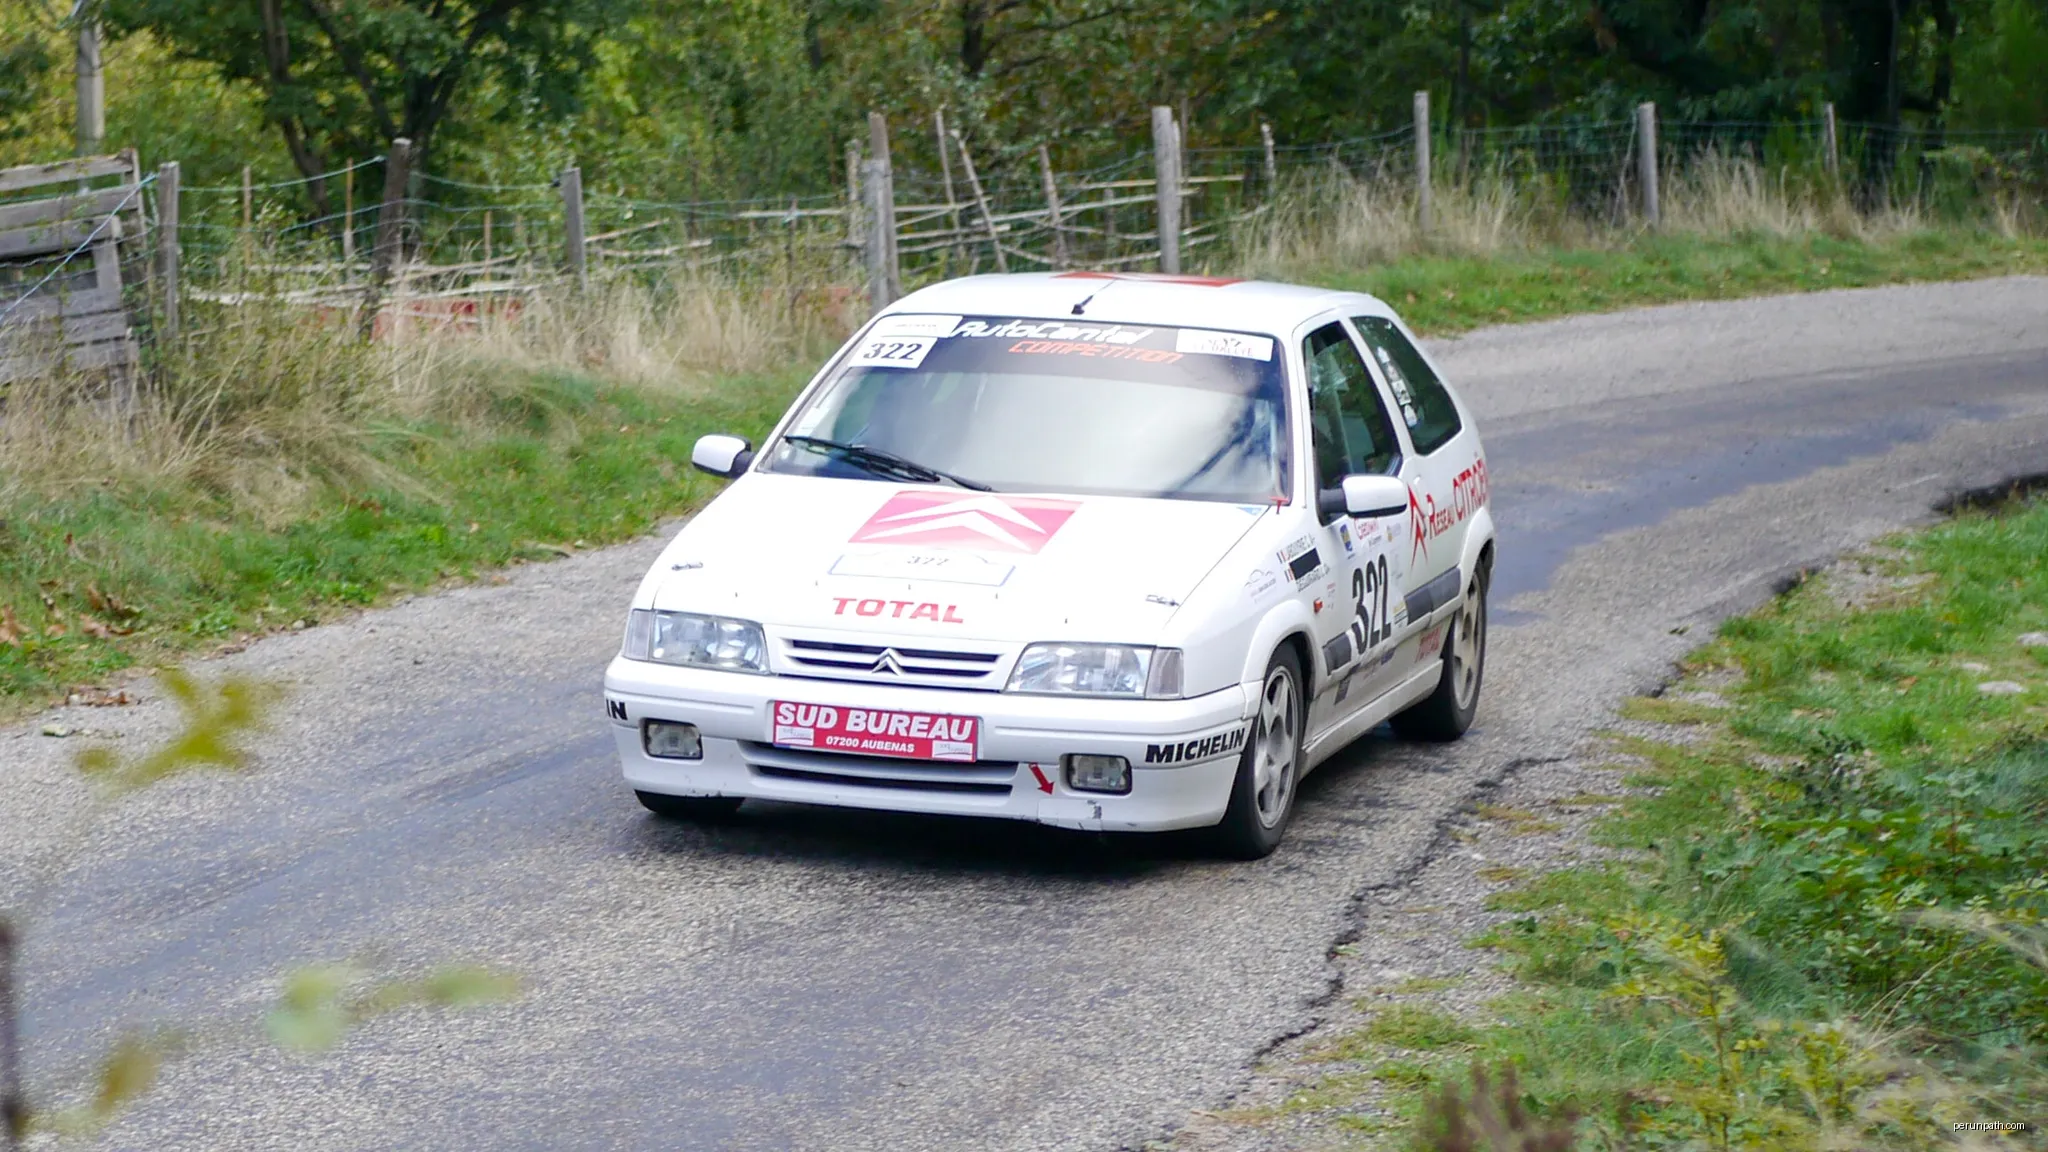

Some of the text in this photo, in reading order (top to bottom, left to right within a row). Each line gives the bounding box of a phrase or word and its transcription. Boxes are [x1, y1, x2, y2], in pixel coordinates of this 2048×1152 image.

[863, 342, 923, 361] 322
[832, 597, 965, 625] TOTAL
[1350, 554, 1392, 656] 322
[776, 702, 974, 742] SUD BUREAU
[825, 735, 916, 754] 07200 AUBENAS
[1145, 727, 1247, 765] MICHELIN
